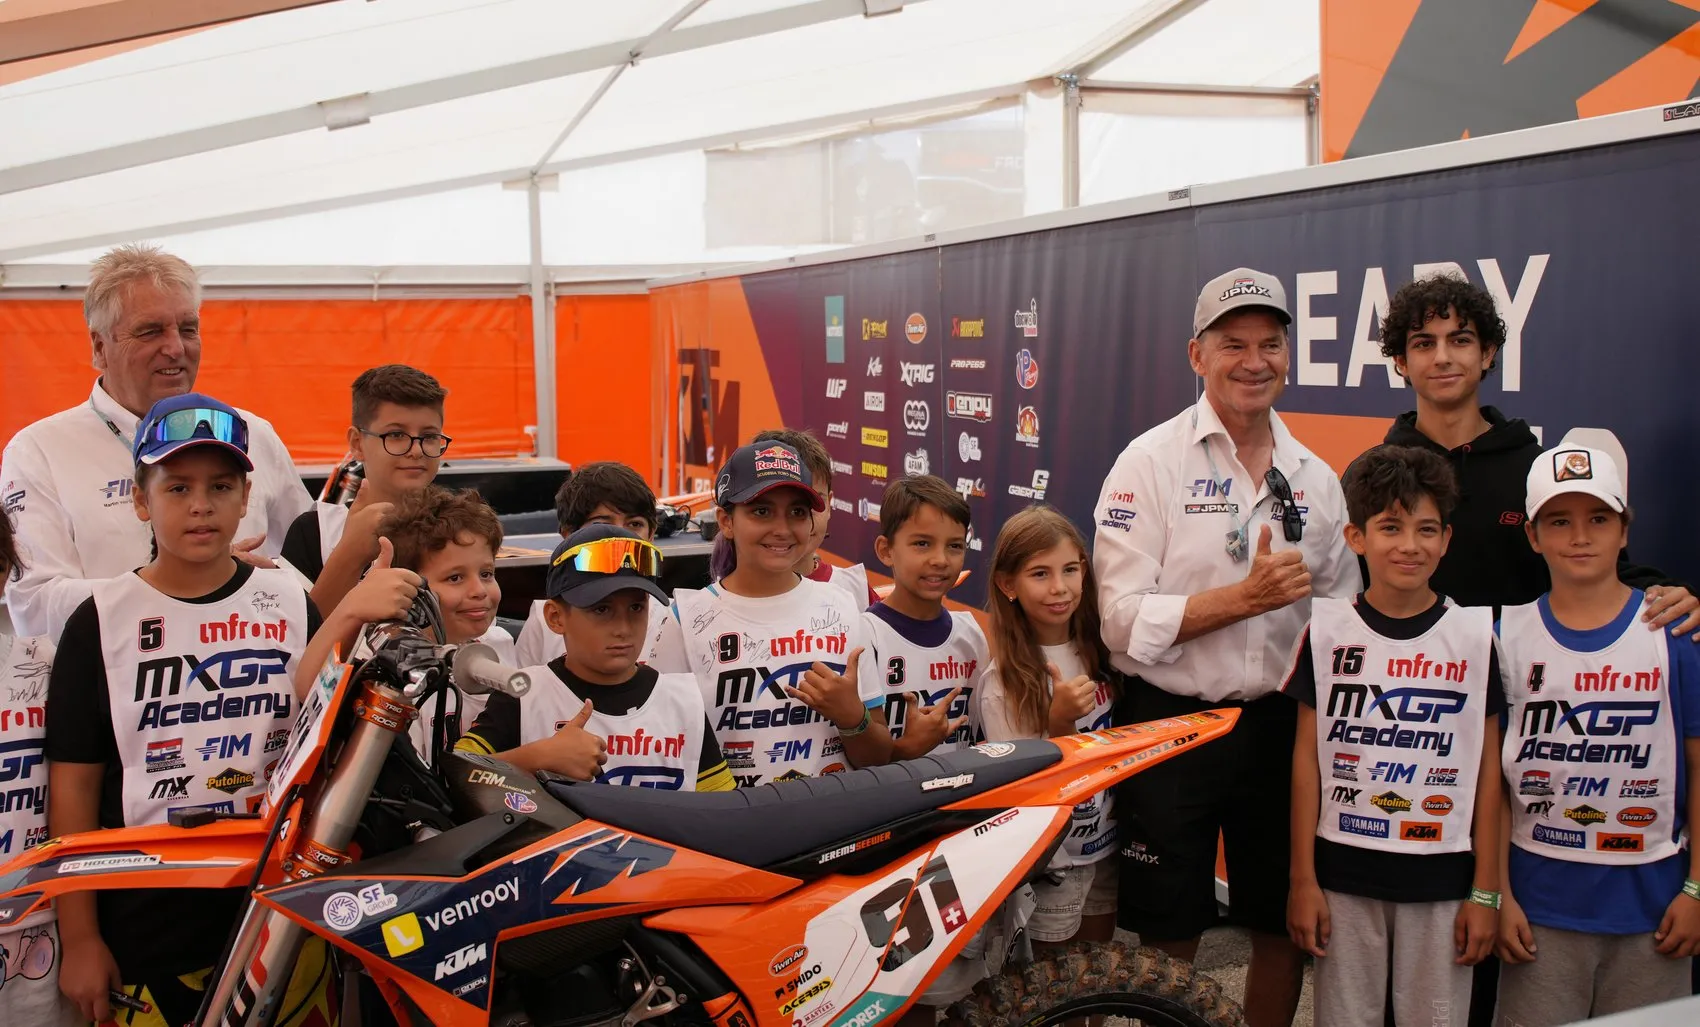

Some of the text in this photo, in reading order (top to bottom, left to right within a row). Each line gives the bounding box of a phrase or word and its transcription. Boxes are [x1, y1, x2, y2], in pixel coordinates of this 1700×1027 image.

[1219, 286, 1271, 301] JPMX
[1286, 254, 1550, 393] EAY
[900, 361, 935, 387] XTRIG
[826, 378, 848, 398] WP
[956, 395, 991, 417] enjoy
[756, 459, 801, 475] Red Bull
[908, 460, 923, 470] AFAM
[1008, 484, 1045, 500] GAERNE
[1185, 478, 1232, 497] FIM
[138, 616, 165, 652] 5
[200, 613, 287, 643] infront
[718, 632, 740, 664] 9
[770, 629, 847, 657] infront
[886, 656, 905, 686] 3
[1332, 645, 1367, 676] 15
[1387, 653, 1468, 683] infront
[134, 649, 292, 702] MXGP
[1526, 662, 1546, 694] 4
[1575, 665, 1660, 692] infront
[137, 693, 291, 731] Academy
[378, 697, 404, 714] XTRIG
[1326, 683, 1468, 723] MXGP
[370, 713, 398, 729] ROCS
[1519, 700, 1660, 737] MXGP
[195, 733, 252, 761] FIM
[607, 728, 685, 758] infront
[1326, 719, 1453, 757] Academy
[764, 739, 813, 763] FIM
[1122, 732, 1199, 768] DUNLOP
[1514, 737, 1652, 769] Academy
[207, 774, 254, 789] Putoline
[1366, 761, 1418, 784] FIM
[1561, 777, 1609, 796] FIM
[1619, 779, 1659, 796] HGS
[1371, 796, 1412, 808] Putoline
[974, 809, 1019, 837] MXGP
[1351, 817, 1386, 832] YAMAHA
[1565, 808, 1607, 820] Putoline
[1621, 813, 1642, 821] Twin
[1405, 825, 1438, 839] KTM
[1544, 829, 1582, 843] YAMAHA
[1601, 837, 1639, 849] KTM
[83, 857, 157, 867] HOCOPARTS
[307, 845, 340, 865] XTRIG
[1121, 848, 1159, 865] JPMX
[362, 887, 382, 904] SF
[367, 897, 396, 913] GROUP
[425, 877, 519, 931] venrooy
[435, 942, 487, 981] KTM
[773, 947, 807, 974] Twin Air
[460, 975, 487, 993] enjoy
[786, 963, 822, 992] SHIDO
[782, 980, 831, 1015] ACERBIS
[804, 1002, 834, 1022] MASTERS
